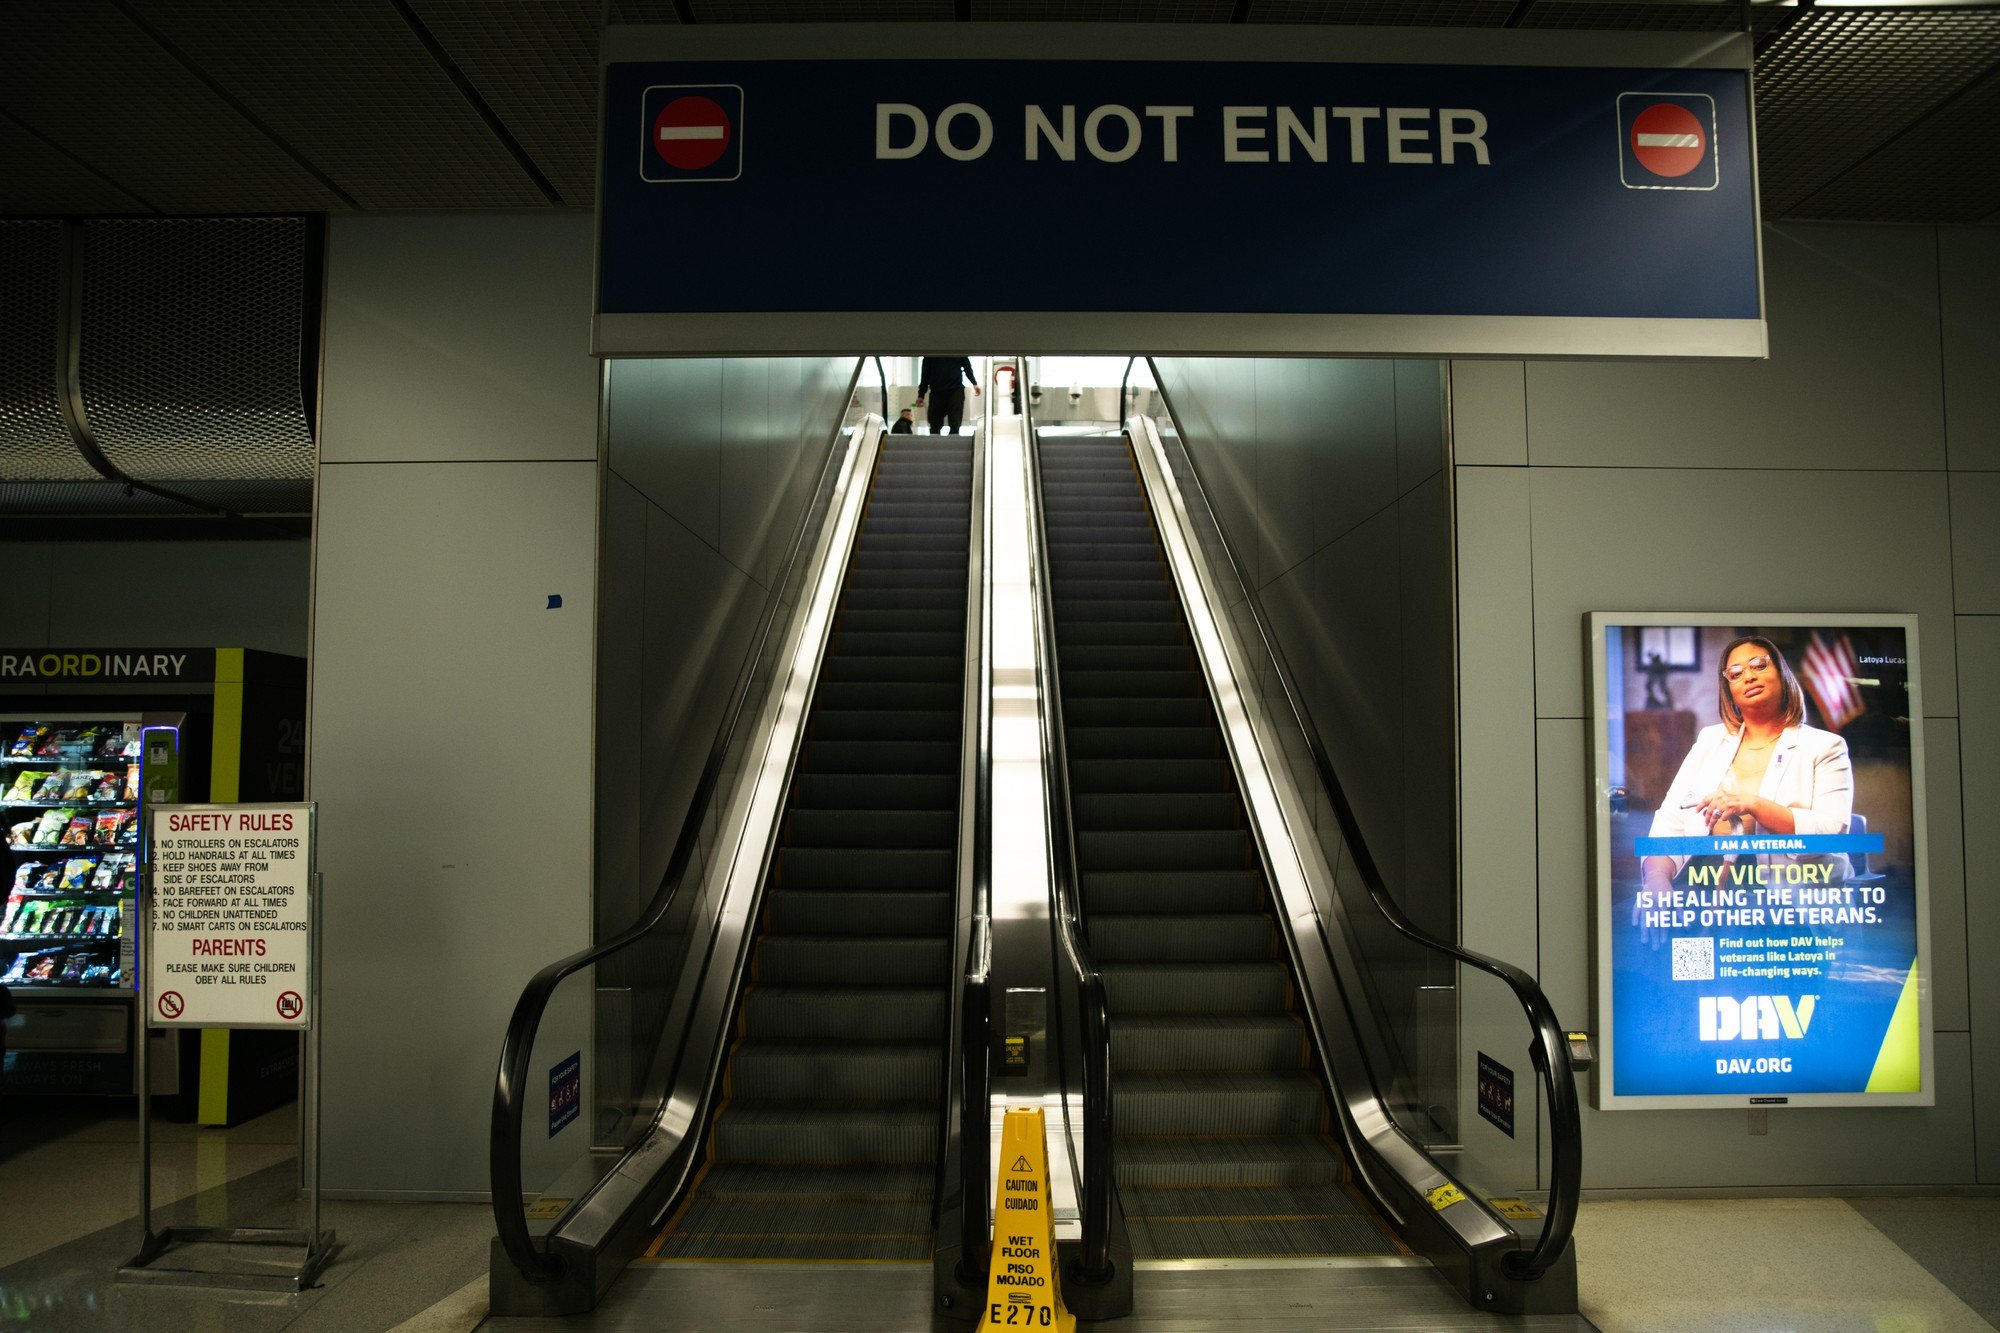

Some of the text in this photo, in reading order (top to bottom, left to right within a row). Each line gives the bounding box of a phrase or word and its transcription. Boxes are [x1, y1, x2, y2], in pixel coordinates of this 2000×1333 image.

[875, 102, 1491, 166] DO NOT ENTER
[0, 654, 187, 677] RAORDINARY
[1860, 656, 1883, 664] Latoya
[169, 814, 293, 831] SAFETY RULES
[161, 840, 173, 848] NO
[177, 840, 225, 848] STROLLERS
[229, 839, 241, 847] ON
[245, 839, 299, 847] ESCALATORS
[1714, 839, 1806, 850] I AM A VETERAN.
[163, 852, 185, 860] HOLD
[188, 851, 235, 860] HANDRAILS
[239, 851, 248, 859] AT
[252, 851, 267, 859] ALL
[270, 851, 295, 859] TIMES
[153, 863, 269, 872] 3. KEEP SHOES AWAY FROM
[163, 875, 255, 883] SIDE OF ESCALATORS
[1688, 864, 1834, 886] MY VICTORY
[163, 887, 175, 895] NO
[179, 887, 221, 895] BAREFEET
[224, 887, 236, 895] ON
[240, 886, 294, 895] ESCALATORS
[153, 898, 287, 907] 5. FACE FORWARD AT ALL TIMES
[1637, 887, 1886, 908] IS HEALING THE HURT TO
[153, 910, 277, 919] 6. NO CHILDREN UNATTENDED
[1645, 907, 1882, 927] HELP OTHER VETERANS.
[153, 923, 159, 931] 7.
[162, 923, 174, 931] NO
[209, 922, 235, 930] CARTS
[239, 922, 250, 930] ON
[254, 922, 307, 930] ESCALATORS
[192, 939, 266, 956] PARENTS
[1720, 936, 1843, 948] Find out how DAV helps
[1720, 951, 1835, 963] veterans like Latoya in
[167, 964, 296, 972] PLEASE MAKE SURE CHILDREN
[1720, 966, 1822, 978] life-changing ways.
[196, 976, 266, 984] OBEY ALL RULES
[1699, 995, 1816, 1041] DAV
[1716, 1058, 1792, 1074] DAV.ORG
[1006, 1179, 1038, 1192] CAUTION
[1005, 1198, 1038, 1211] CUIDADO
[1009, 1236, 1033, 1246] WET
[1002, 1248, 1039, 1258] FLOOR
[1008, 1264, 1034, 1273] PISO
[997, 1275, 1044, 1287] MOJADO
